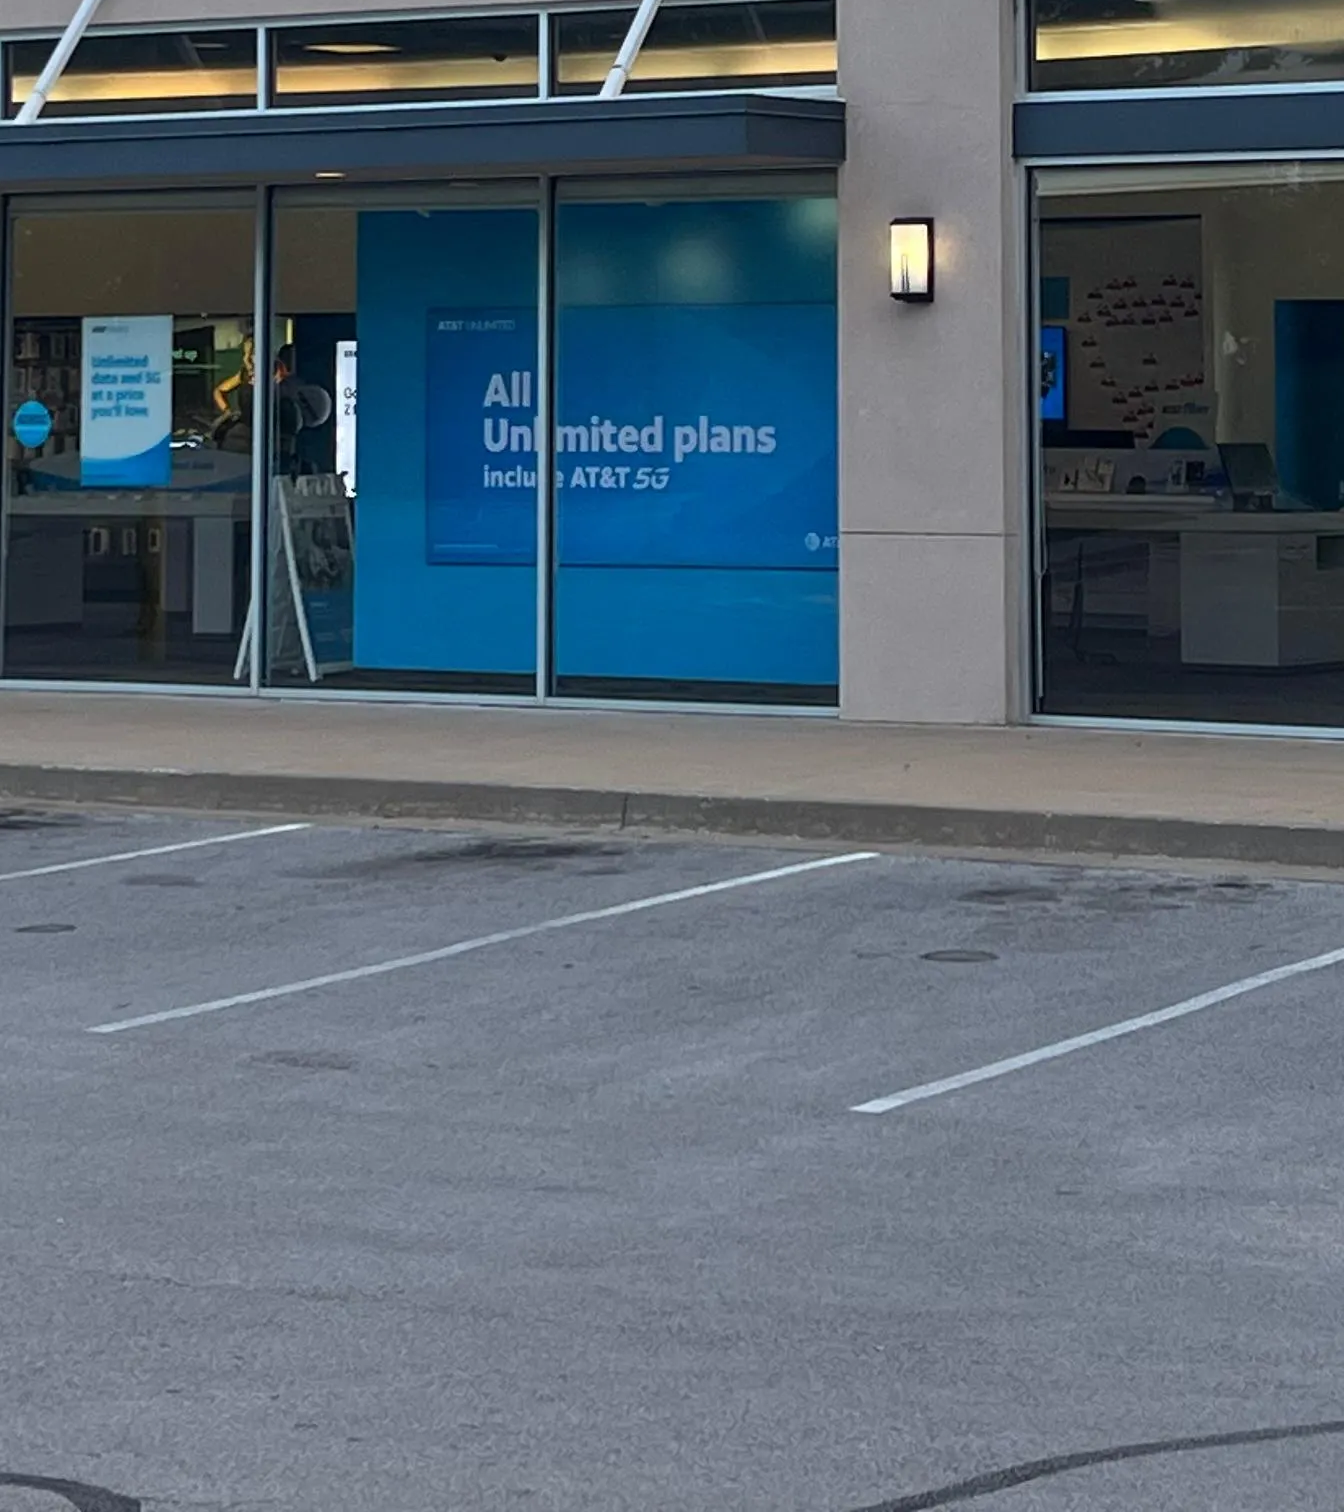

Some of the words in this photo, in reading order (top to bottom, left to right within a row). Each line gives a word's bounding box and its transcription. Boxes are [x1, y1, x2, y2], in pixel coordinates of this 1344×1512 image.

[438, 320, 464, 331] AT&T
[91, 354, 149, 368] Unlimited
[91, 372, 118, 385] data
[120, 371, 142, 385] and
[483, 370, 531, 408] All
[91, 390, 104, 401] at
[116, 390, 145, 405] price
[483, 416, 663, 454] Unlmited
[674, 416, 777, 463] plans
[483, 465, 564, 489] inclue
[570, 466, 631, 489] AT&T
[632, 467, 671, 490] 5G
